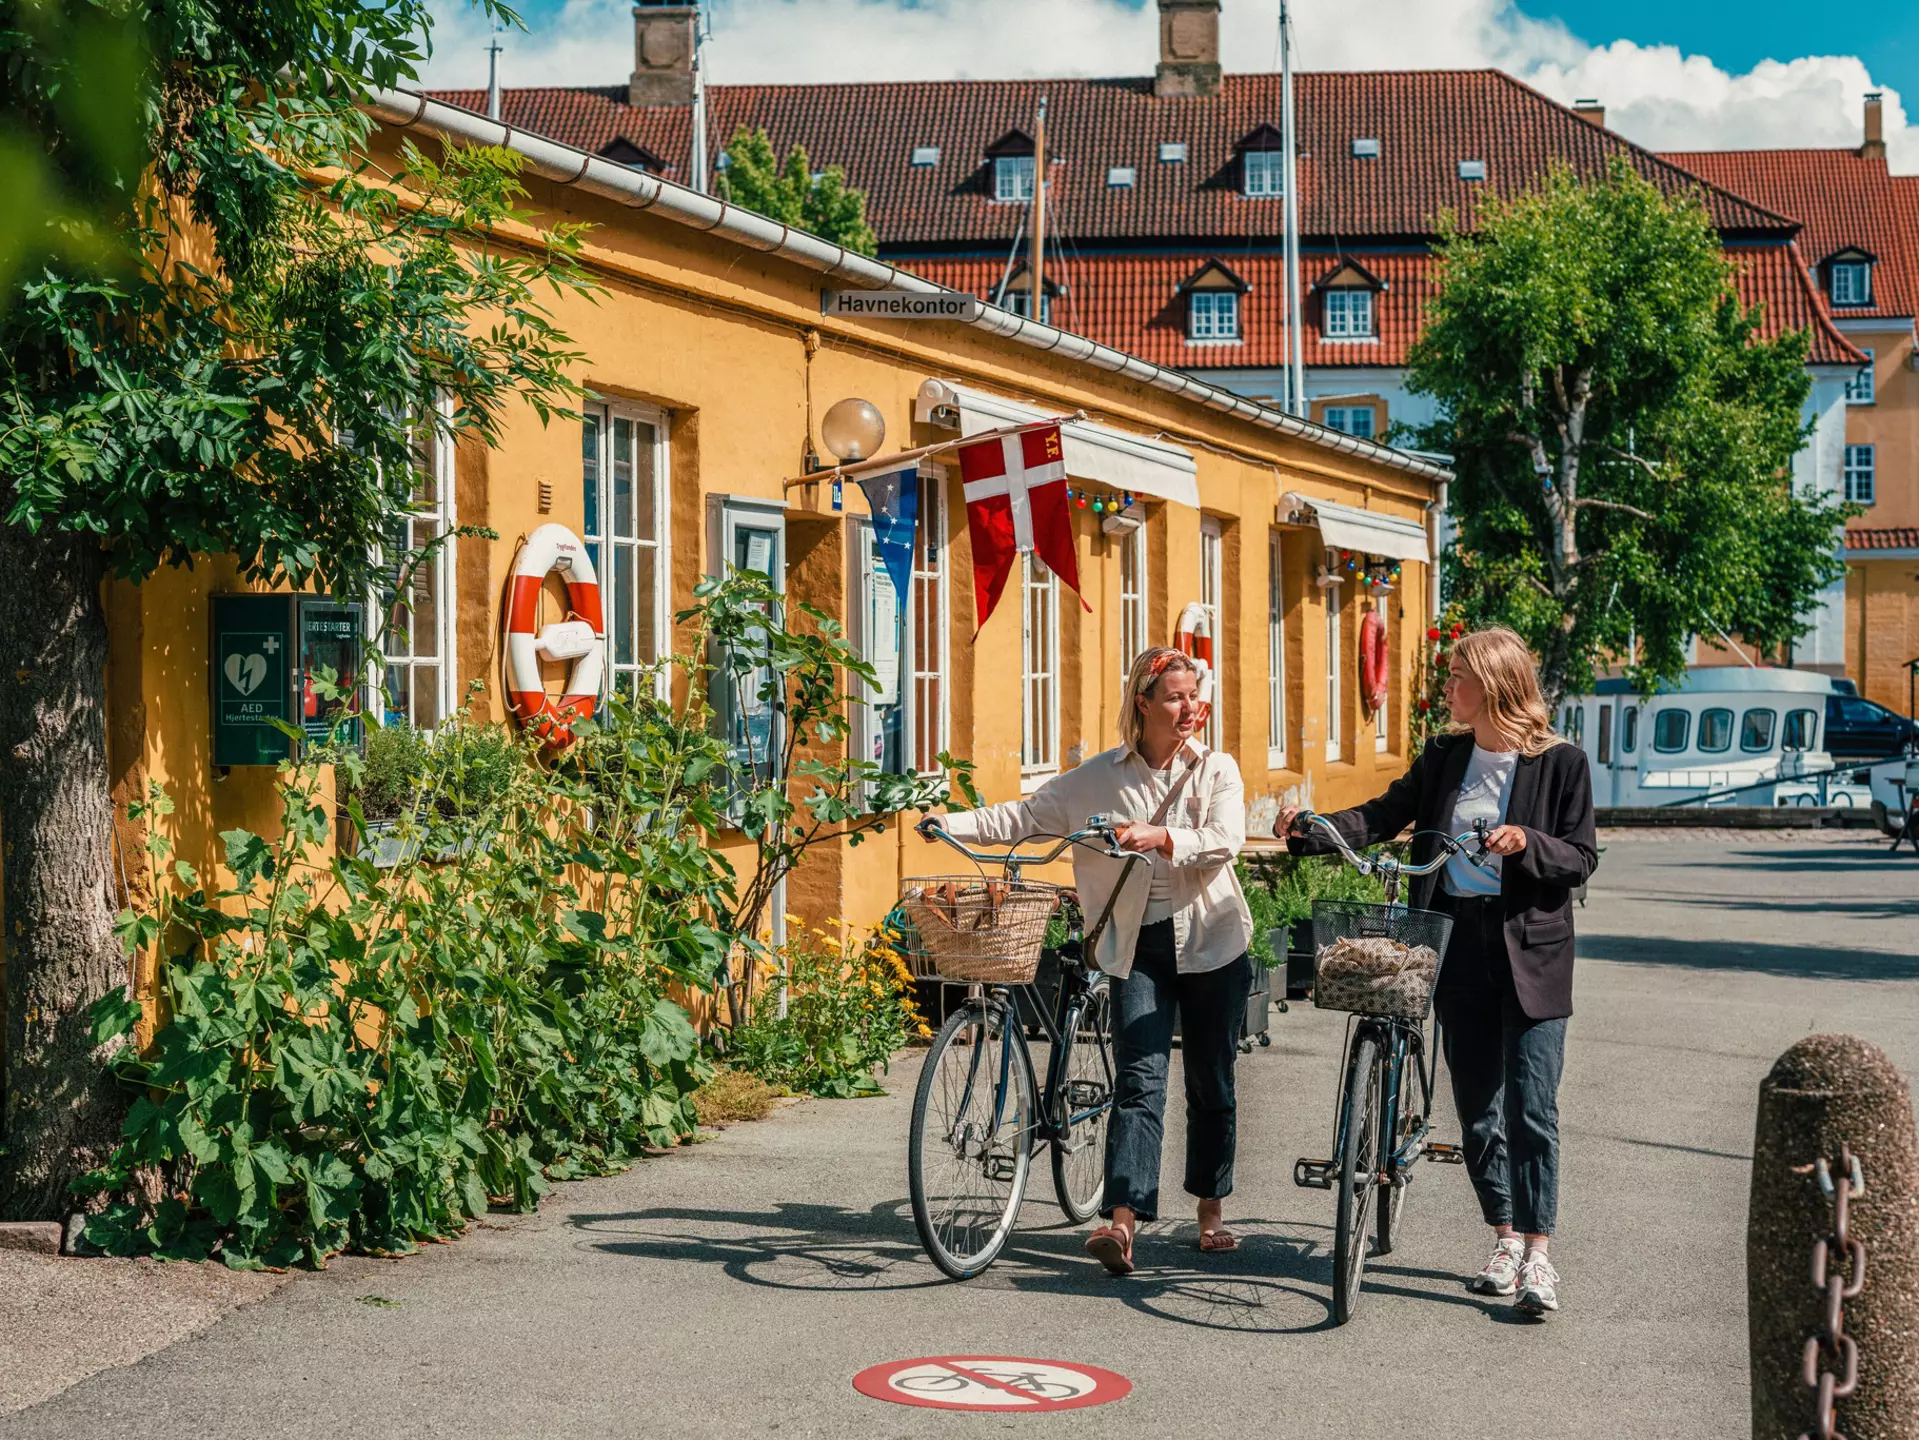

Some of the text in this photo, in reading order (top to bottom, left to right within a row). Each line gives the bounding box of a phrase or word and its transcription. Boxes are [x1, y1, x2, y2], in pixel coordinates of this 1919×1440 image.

[838, 294, 967, 314] Havnekontor
[305, 620, 352, 632] JERTESTARTER
[240, 703, 264, 713] AED
[225, 713, 279, 723] Hjertestaer
